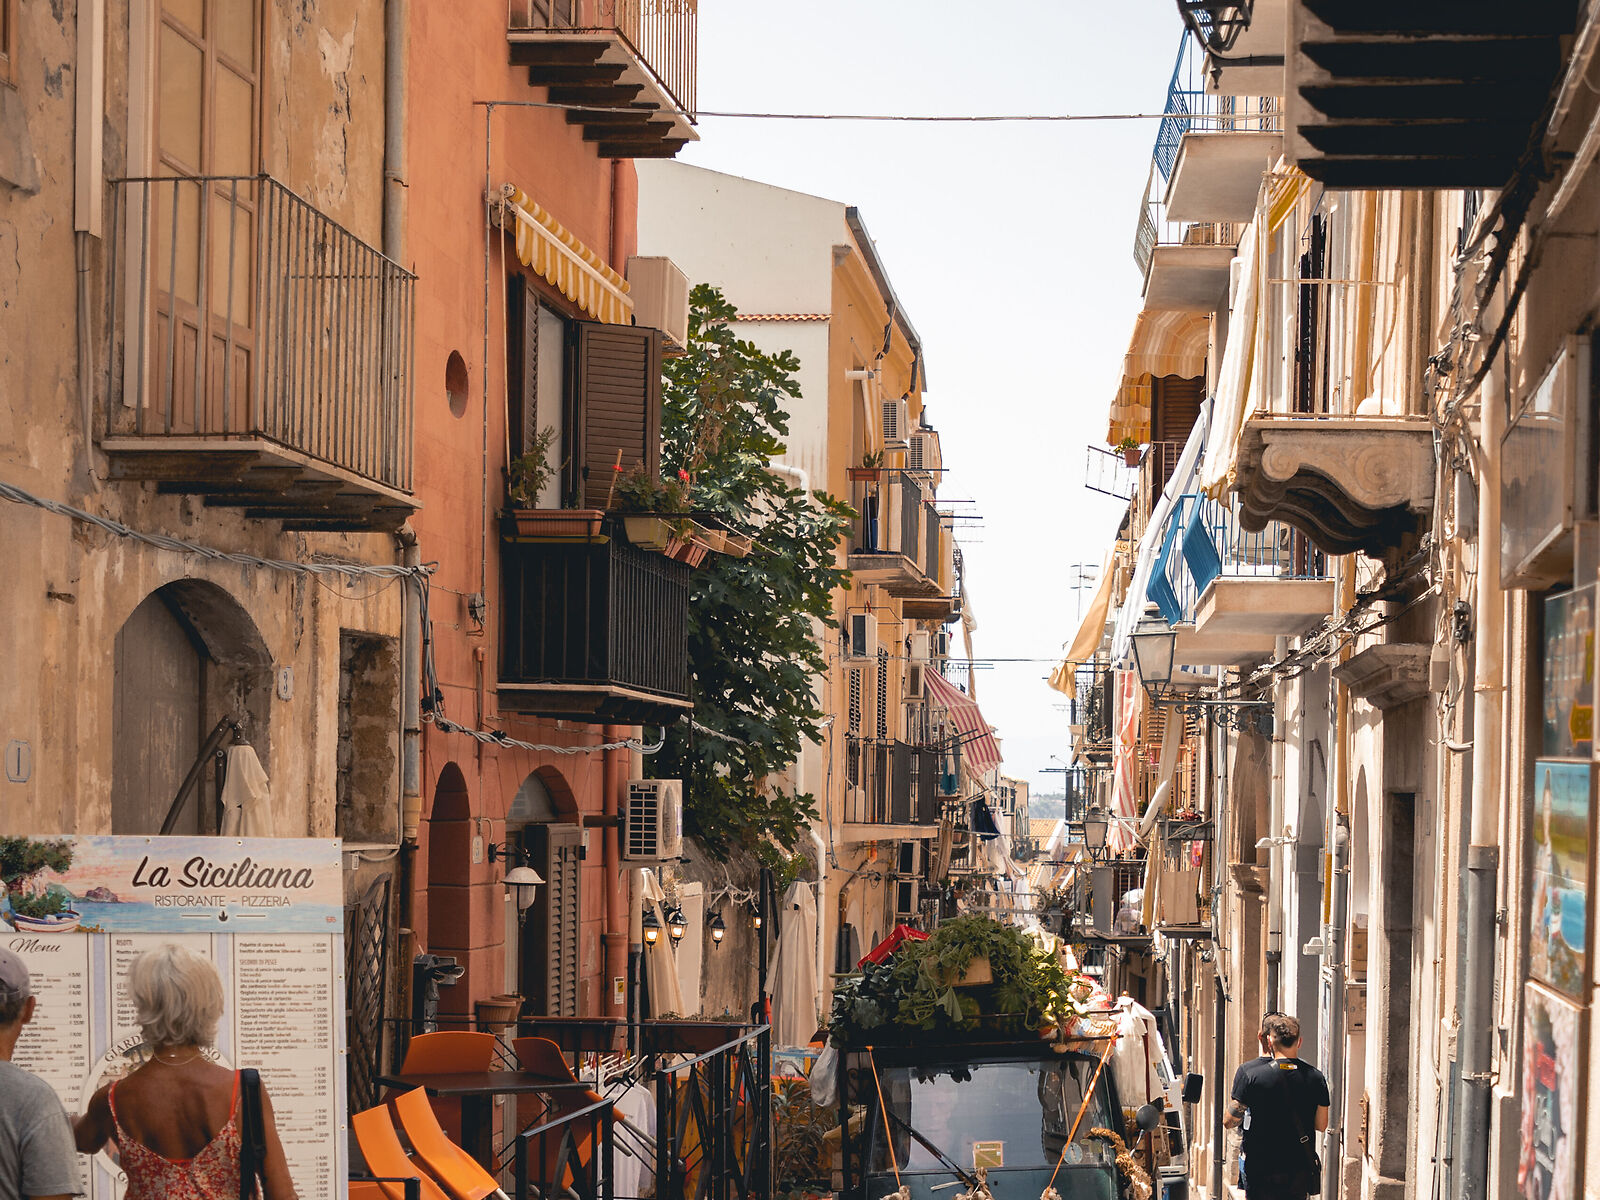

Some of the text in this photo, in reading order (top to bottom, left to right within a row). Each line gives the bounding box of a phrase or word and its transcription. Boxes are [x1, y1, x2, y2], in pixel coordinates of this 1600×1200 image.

[132, 856, 314, 888] La Siciliana
[154, 895, 226, 906] RISTORANTE
[242, 895, 290, 906] PIZZERIA
[9, 938, 62, 953] Menu
[105, 1035, 140, 1062] GIARD
